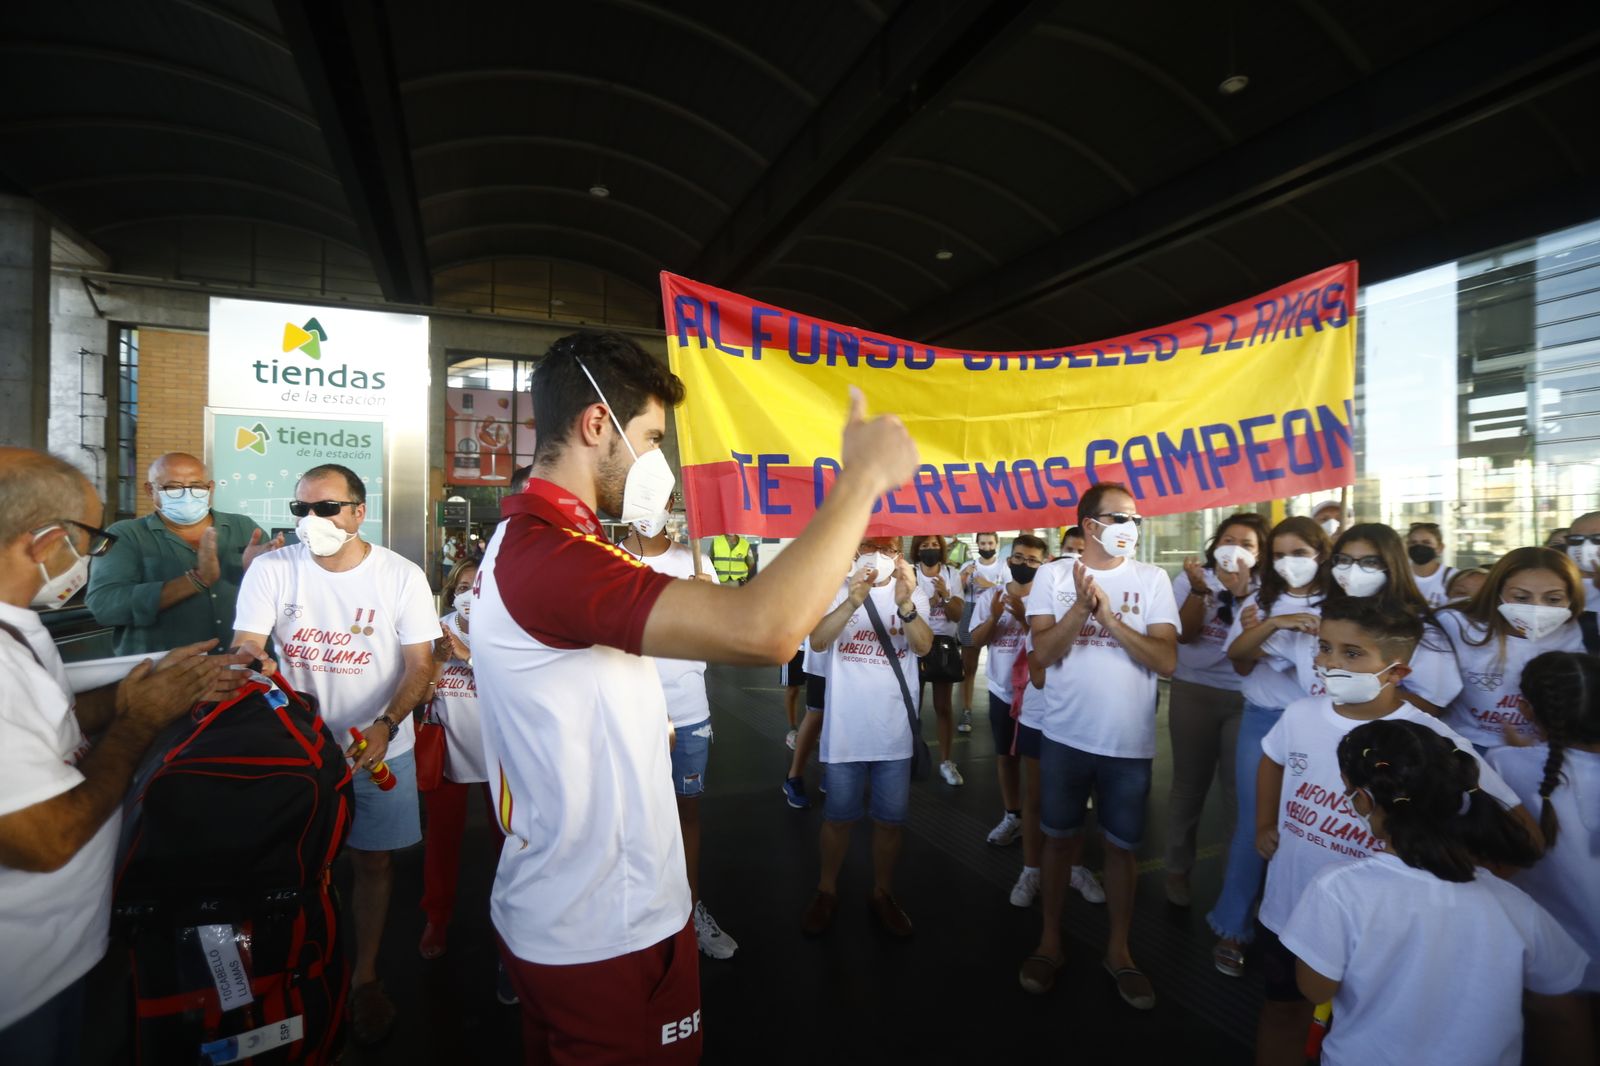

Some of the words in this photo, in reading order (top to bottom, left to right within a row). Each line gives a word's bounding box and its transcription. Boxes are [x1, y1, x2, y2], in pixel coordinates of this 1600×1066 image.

[1194, 282, 1349, 356] LLAMAS
[252, 359, 386, 390] tiendas
[281, 389, 300, 402] de
[305, 391, 317, 403] la
[322, 393, 386, 406] estación
[277, 427, 371, 448] tiendas
[296, 448, 311, 457] de
[313, 448, 322, 458] la
[326, 449, 372, 460] estación
[731, 449, 792, 515] TE
[813, 456, 1078, 515] EREMOS
[1085, 399, 1353, 500] CAMPEON
[292, 628, 352, 646] ALFONSO
[283, 643, 320, 661] ABELLO
[322, 648, 373, 665] LLAMAS
[838, 642, 874, 656] CABELLO
[312, 664, 328, 673] DEL
[1306, 833, 1327, 848] DEL
[1330, 842, 1369, 859] MUND
[229, 960, 248, 997] LLAMAS
[280, 1023, 290, 1041] ESP
